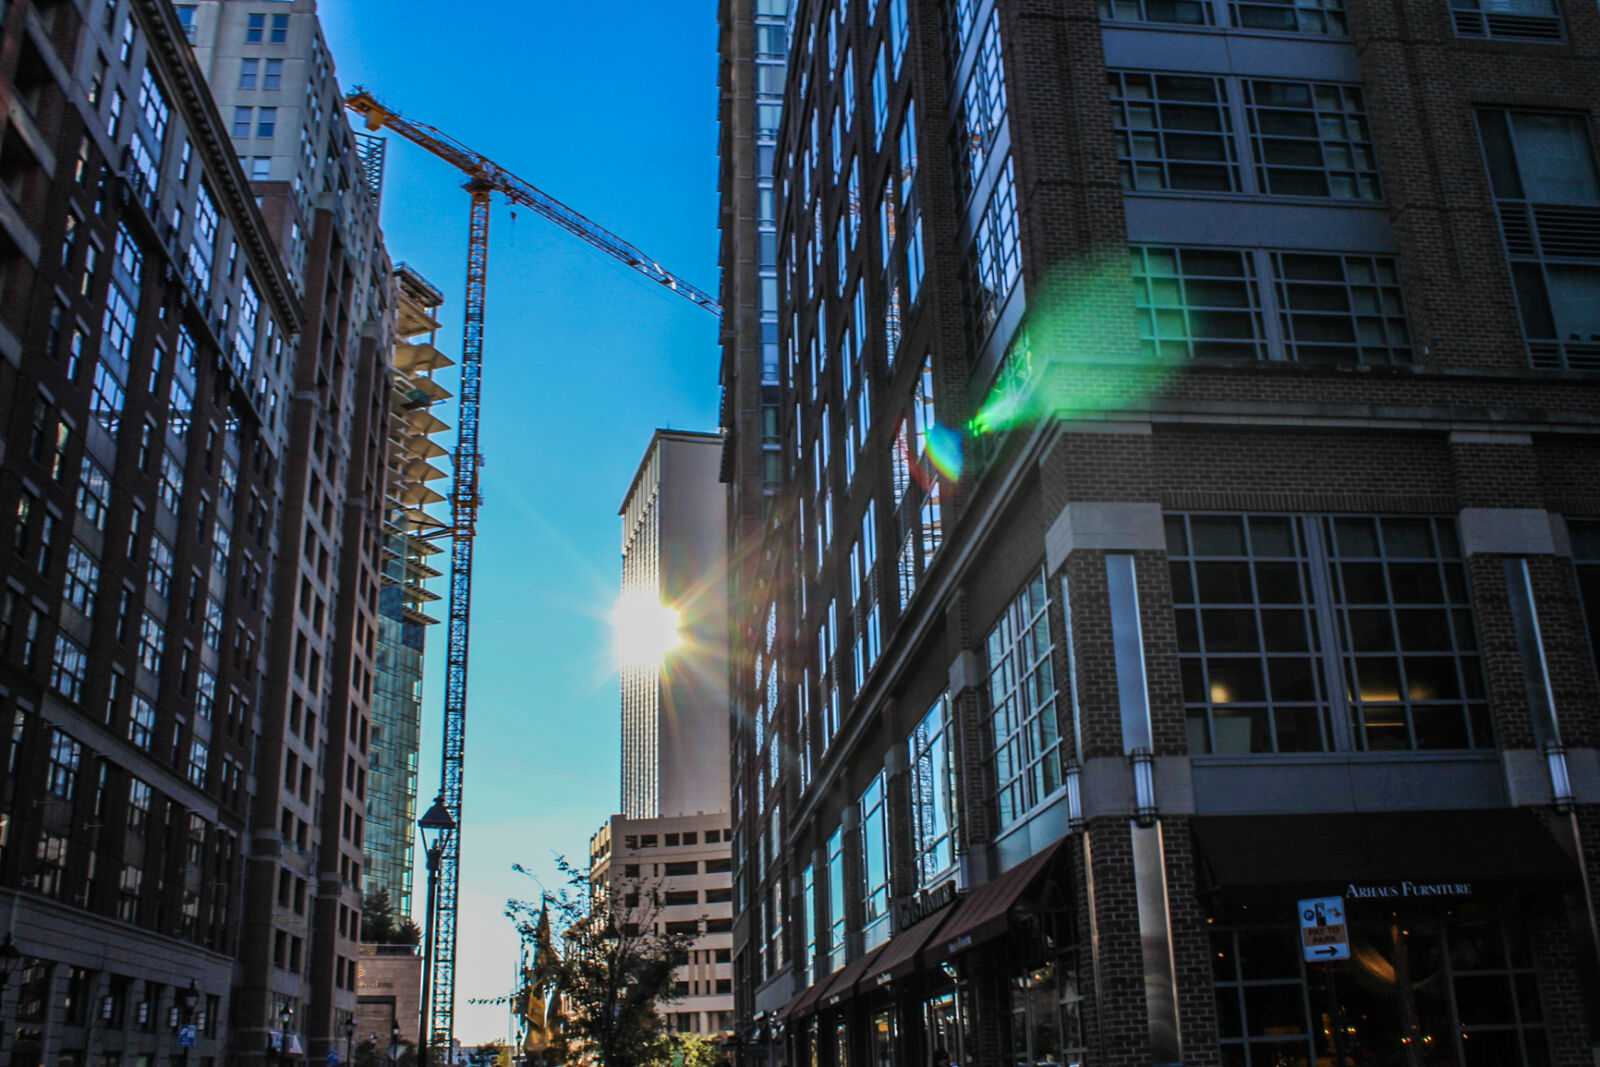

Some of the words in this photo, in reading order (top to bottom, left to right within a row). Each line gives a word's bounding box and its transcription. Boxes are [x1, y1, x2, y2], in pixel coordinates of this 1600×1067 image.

[1346, 884, 1399, 898] ARHAUS
[1401, 881, 1472, 896] FURNITURE
[1308, 928, 1325, 936] PAY
[1328, 926, 1340, 935] TO
[1313, 935, 1337, 944] PARK
